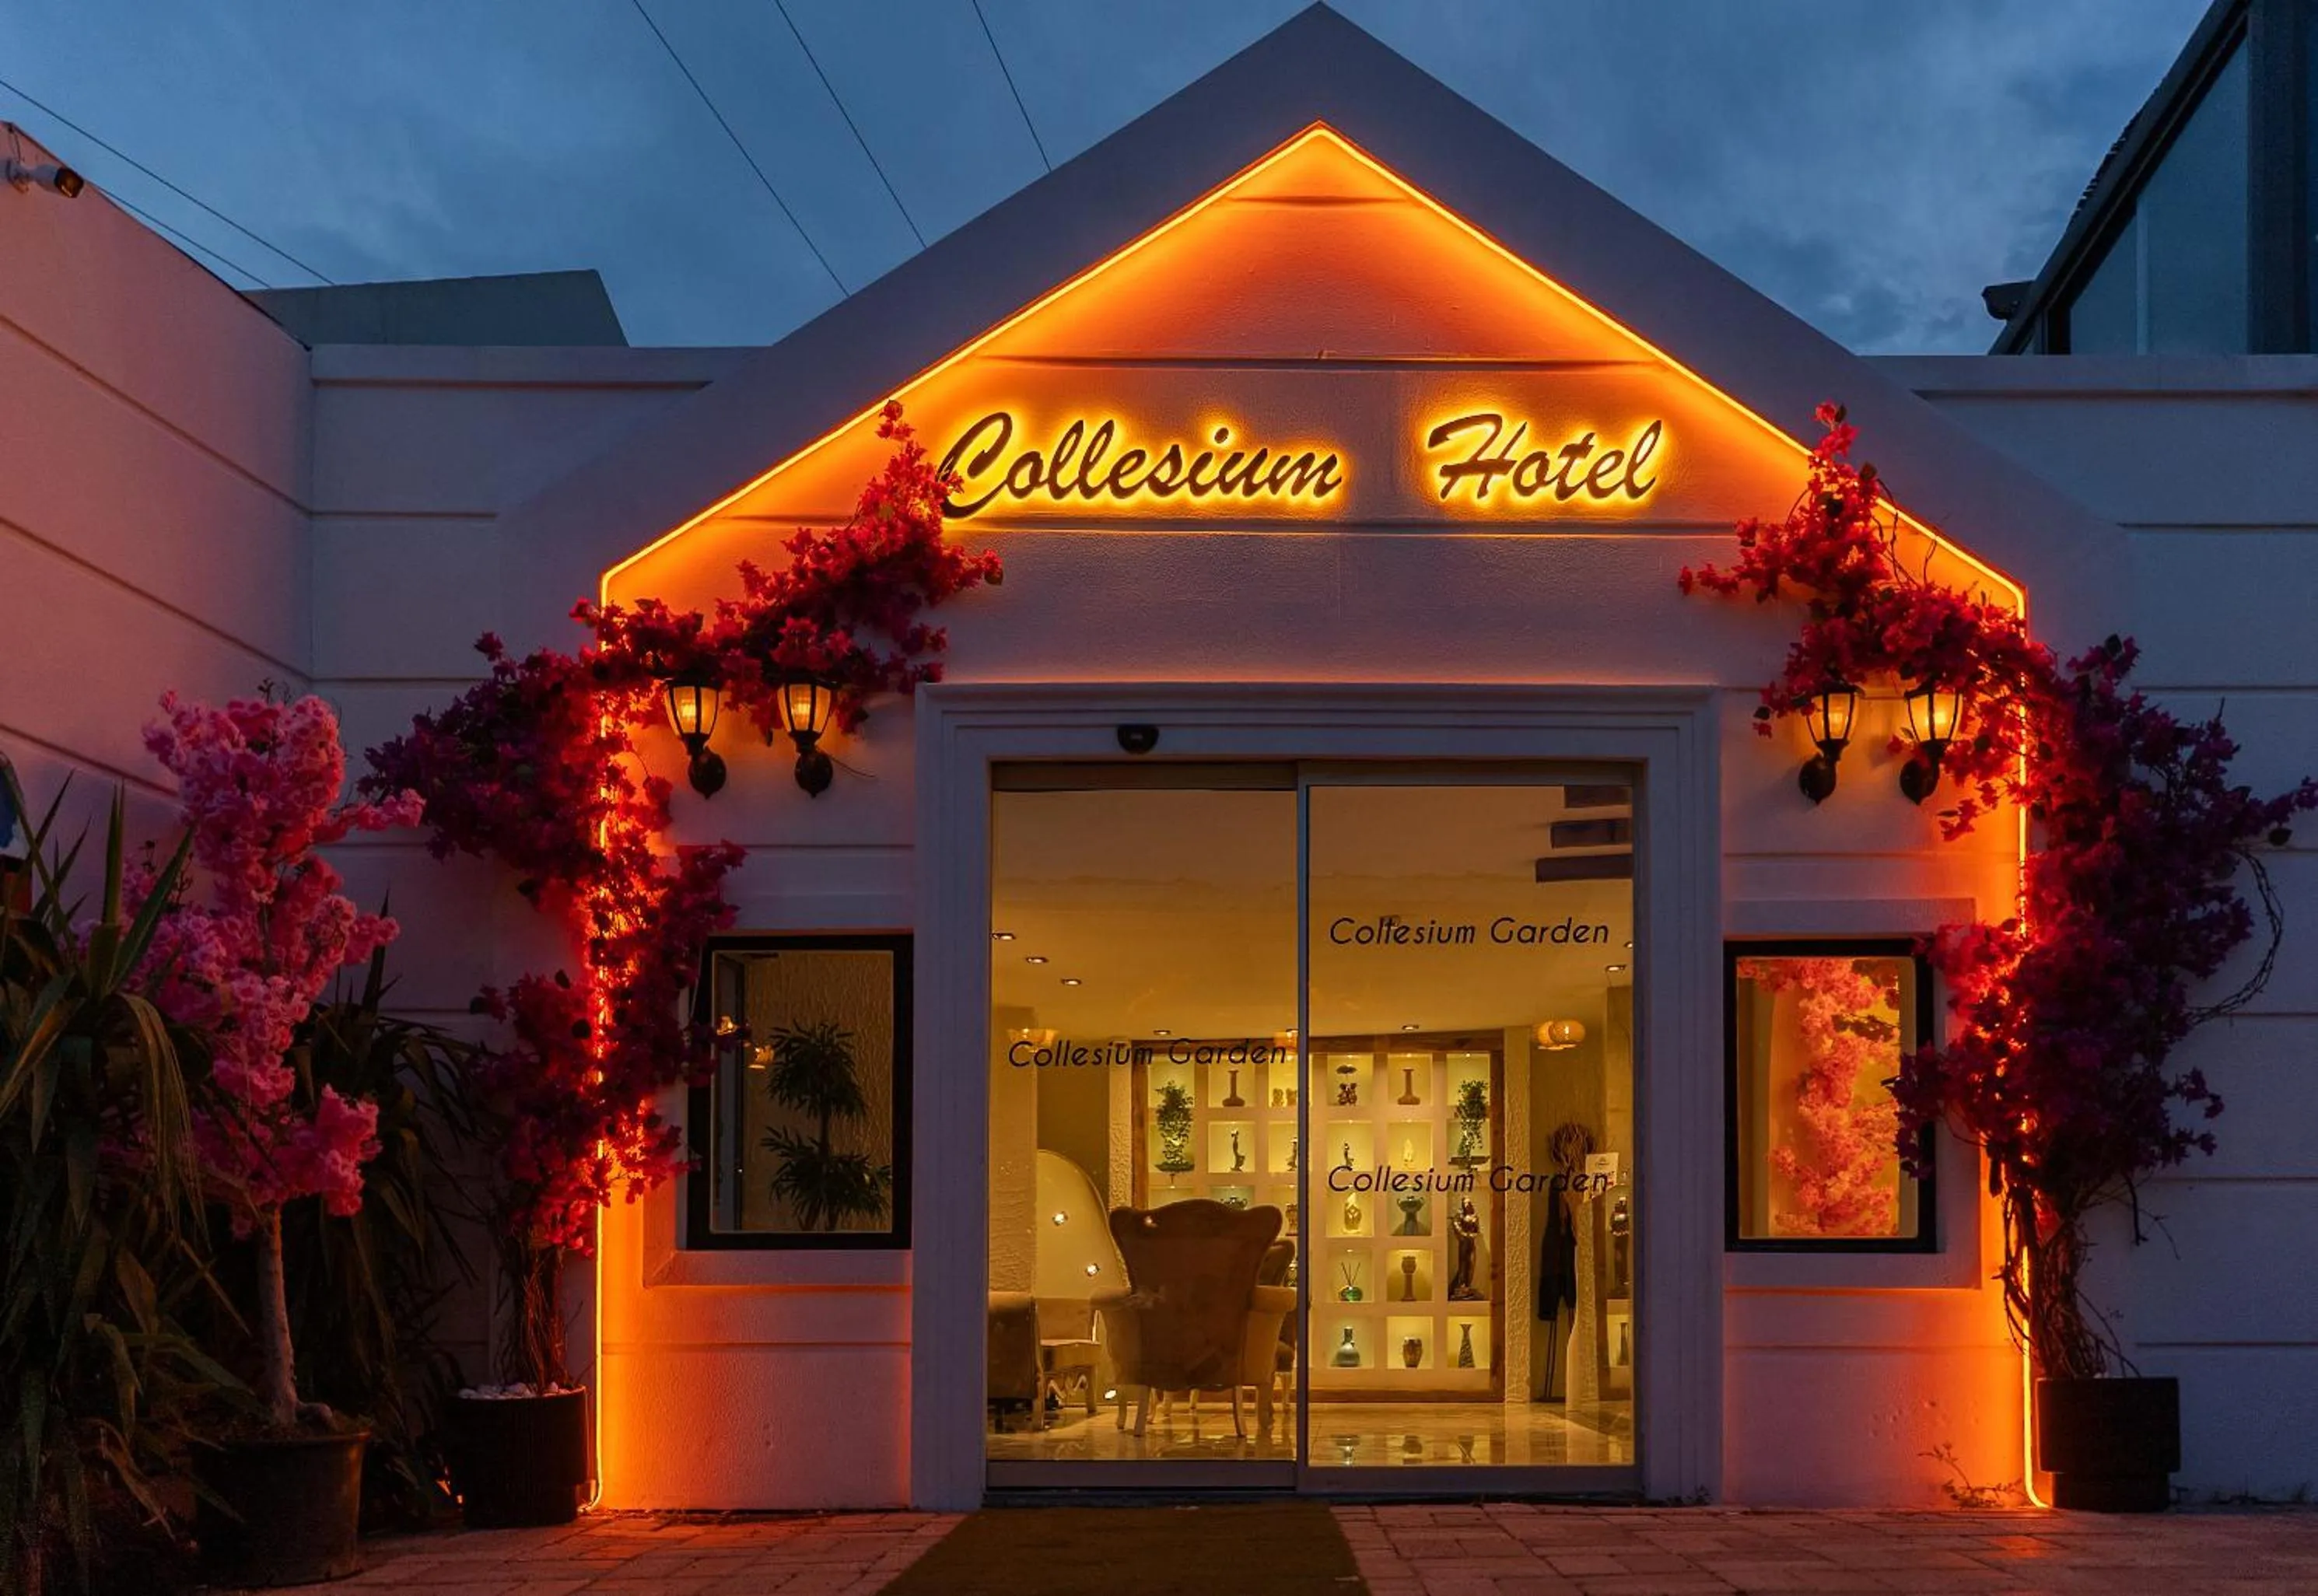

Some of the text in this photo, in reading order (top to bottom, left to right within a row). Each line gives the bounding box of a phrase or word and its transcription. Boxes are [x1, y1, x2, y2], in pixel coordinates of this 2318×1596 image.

[936, 411, 1661, 519] Collesium Hotel
[1329, 916, 1609, 944] Collesium Garden
[1008, 1038, 1287, 1067] Collesium Garden
[1329, 1165, 1473, 1192] Collesium
[1490, 1165, 1609, 1192] Garden
